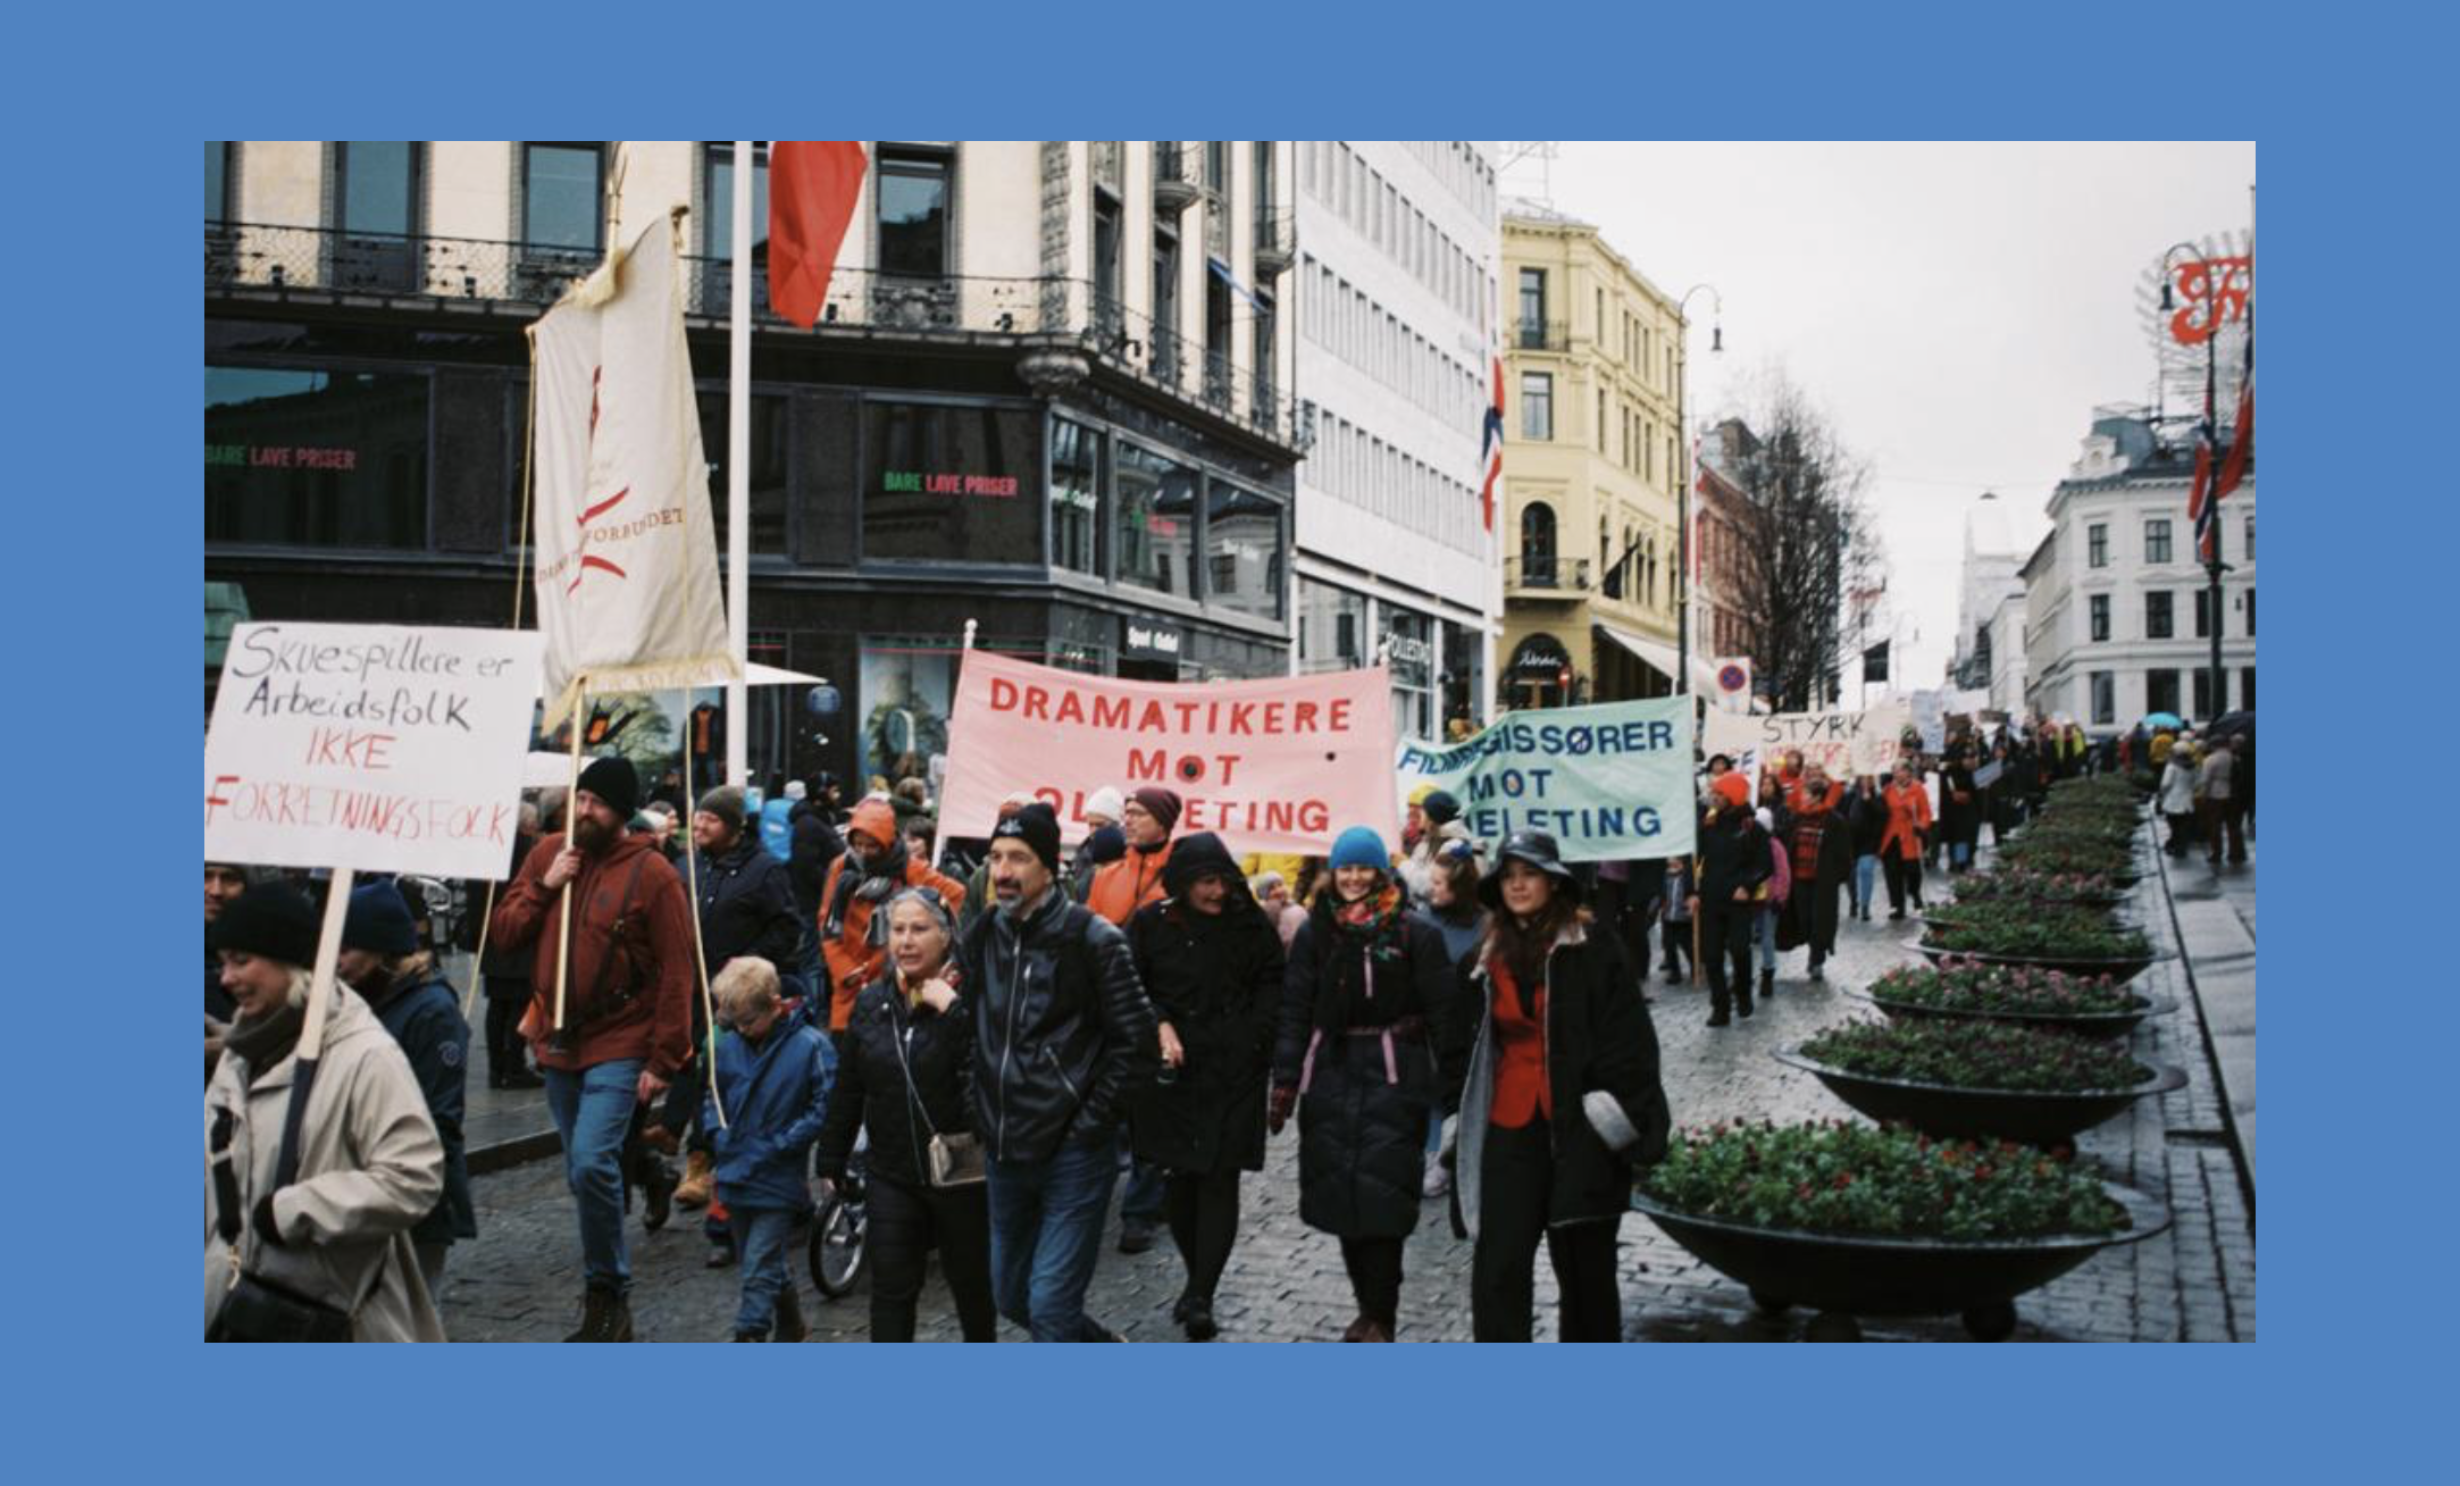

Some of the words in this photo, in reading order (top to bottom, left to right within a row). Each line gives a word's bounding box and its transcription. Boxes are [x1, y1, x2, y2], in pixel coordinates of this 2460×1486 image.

[251, 446, 293, 468] LAVE
[297, 448, 357, 471] PRISER
[885, 472, 921, 492] BARE
[926, 474, 961, 494] LAVE
[965, 476, 1018, 497] PRISER
[477, 655, 513, 678] er
[990, 677, 1351, 736] DRAMATIKERE
[306, 727, 397, 769] IKKE
[1127, 749, 1241, 787] MOT
[1467, 768, 1554, 802] MOT
[205, 775, 512, 846] FORRETNINGSFOLK
[1032, 786, 1330, 833] OLETING
